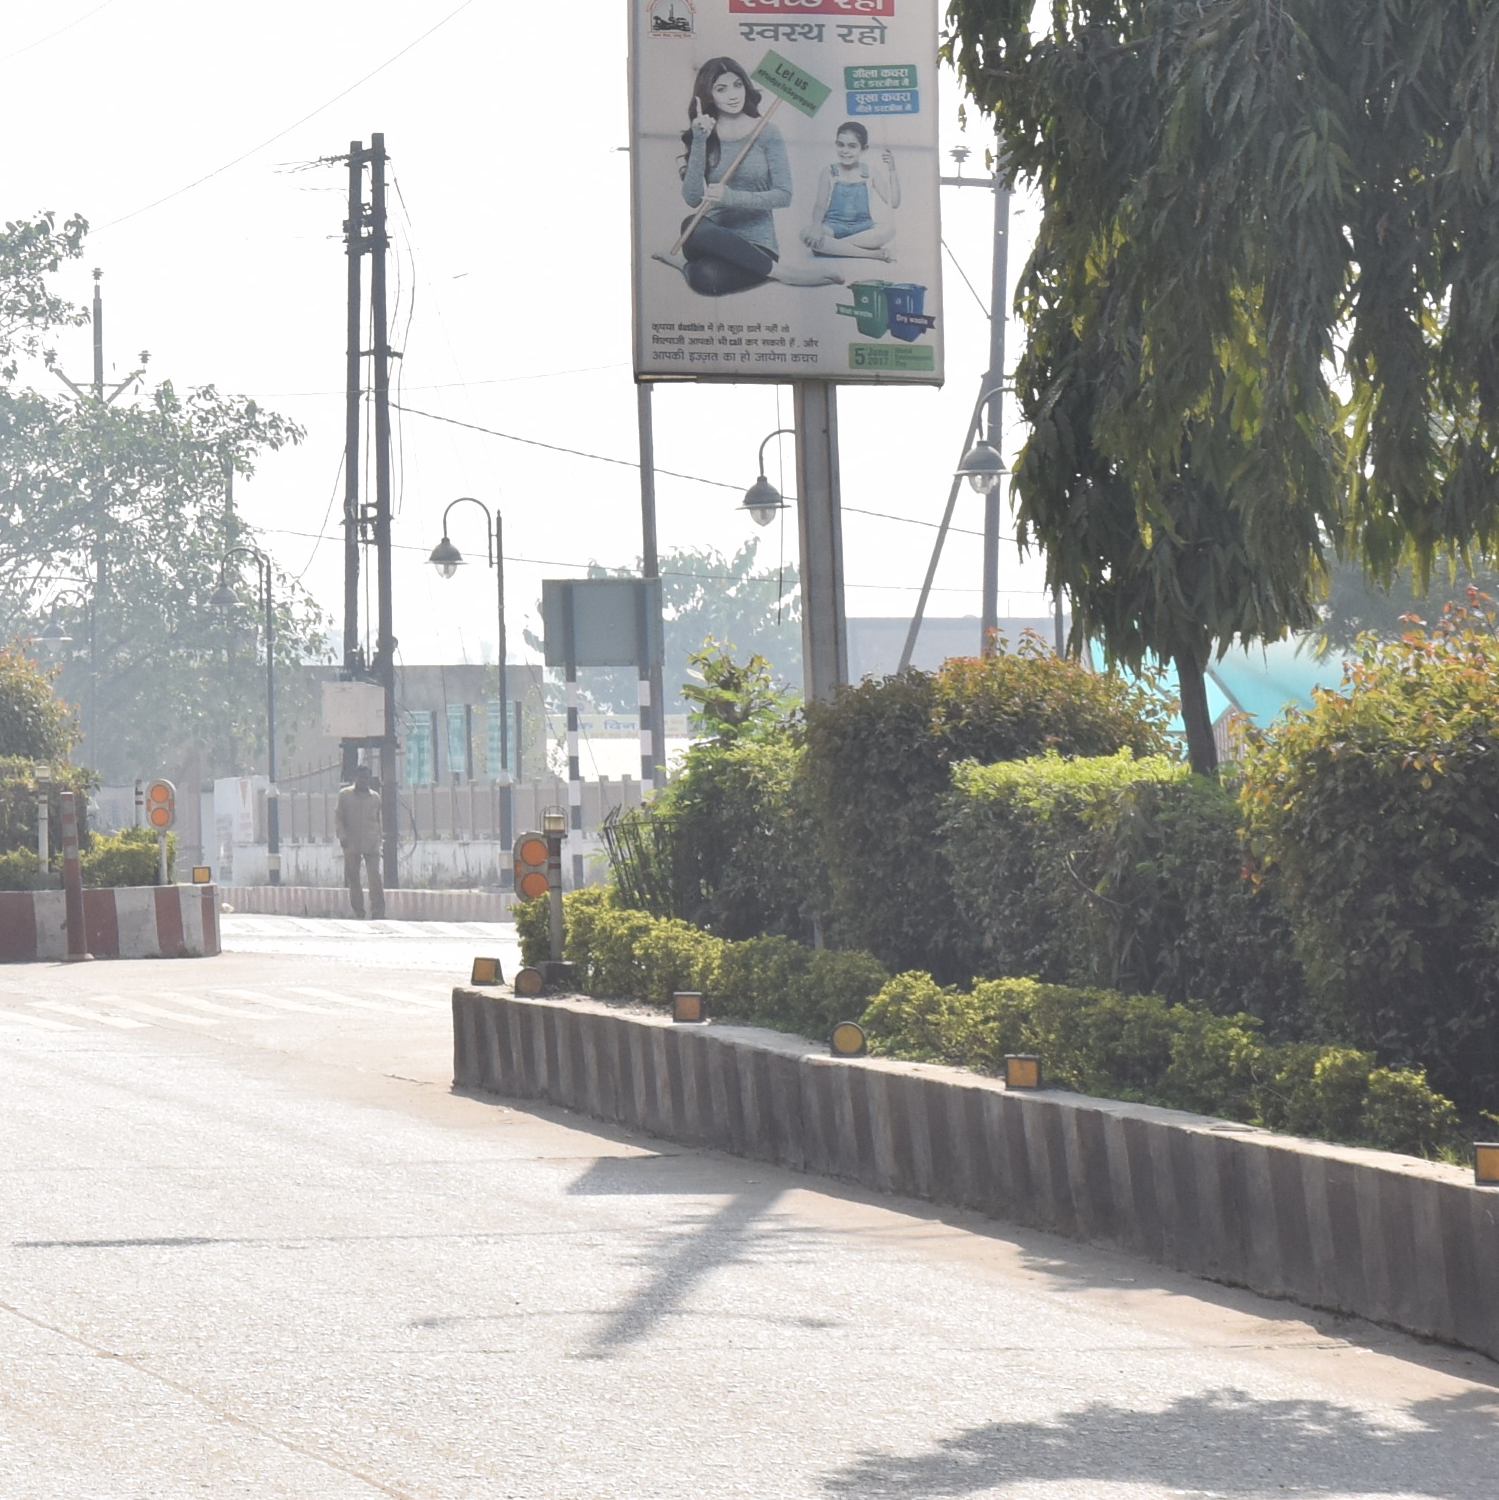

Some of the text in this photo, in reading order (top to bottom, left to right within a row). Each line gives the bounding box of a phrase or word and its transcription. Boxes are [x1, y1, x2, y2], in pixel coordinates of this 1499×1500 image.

[738, 16, 888, 46] स्वस्थ रहो
[775, 63, 809, 91] Let us
[652, 348, 685, 361] आपकी
[722, 352, 736, 361] का
[739, 350, 751, 363] हो
[754, 350, 787, 363] जायेगा
[790, 353, 819, 363] कचरा
[854, 347, 865, 366] 5
